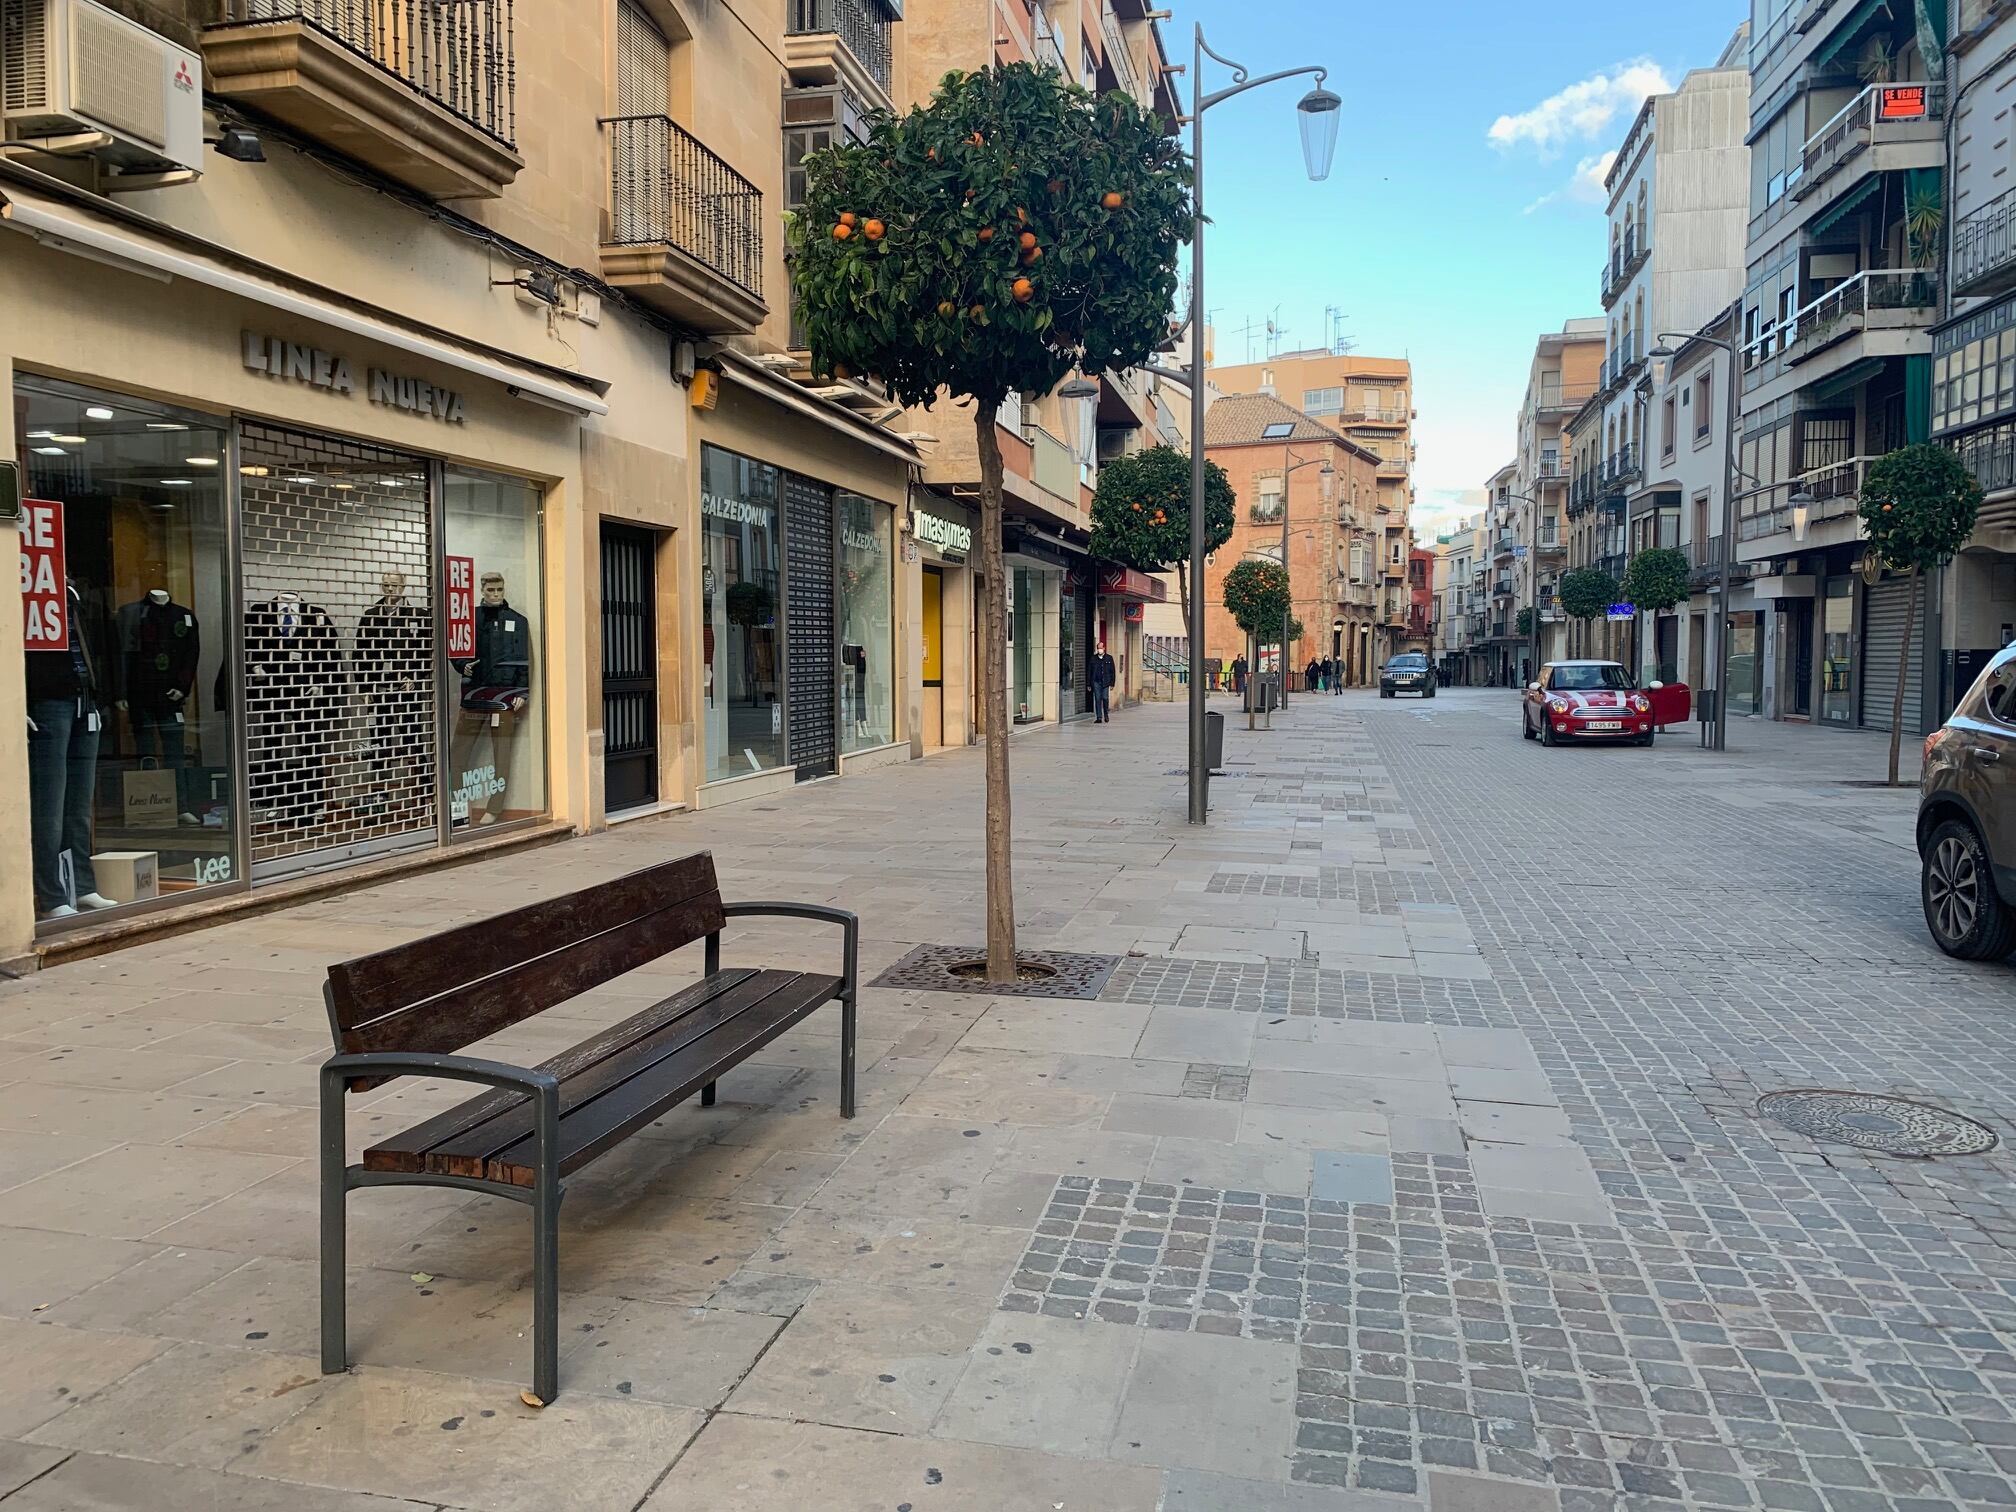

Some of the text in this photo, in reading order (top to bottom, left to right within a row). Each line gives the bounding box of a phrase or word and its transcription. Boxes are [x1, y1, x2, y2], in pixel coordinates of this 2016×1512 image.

[1884, 88, 1923, 100] SE VENDE
[242, 331, 465, 423] LINEA NUEVA
[19, 506, 54, 548] RE
[702, 493, 767, 528] CALZEDONIA
[920, 512, 971, 551] masymas
[20, 553, 58, 594] BA
[449, 560, 470, 588] RE
[26, 600, 62, 641] AS
[450, 592, 470, 620] BA
[449, 623, 472, 652] JAS
[453, 777, 506, 804] YOUR Lee
[194, 855, 231, 886] Lee
